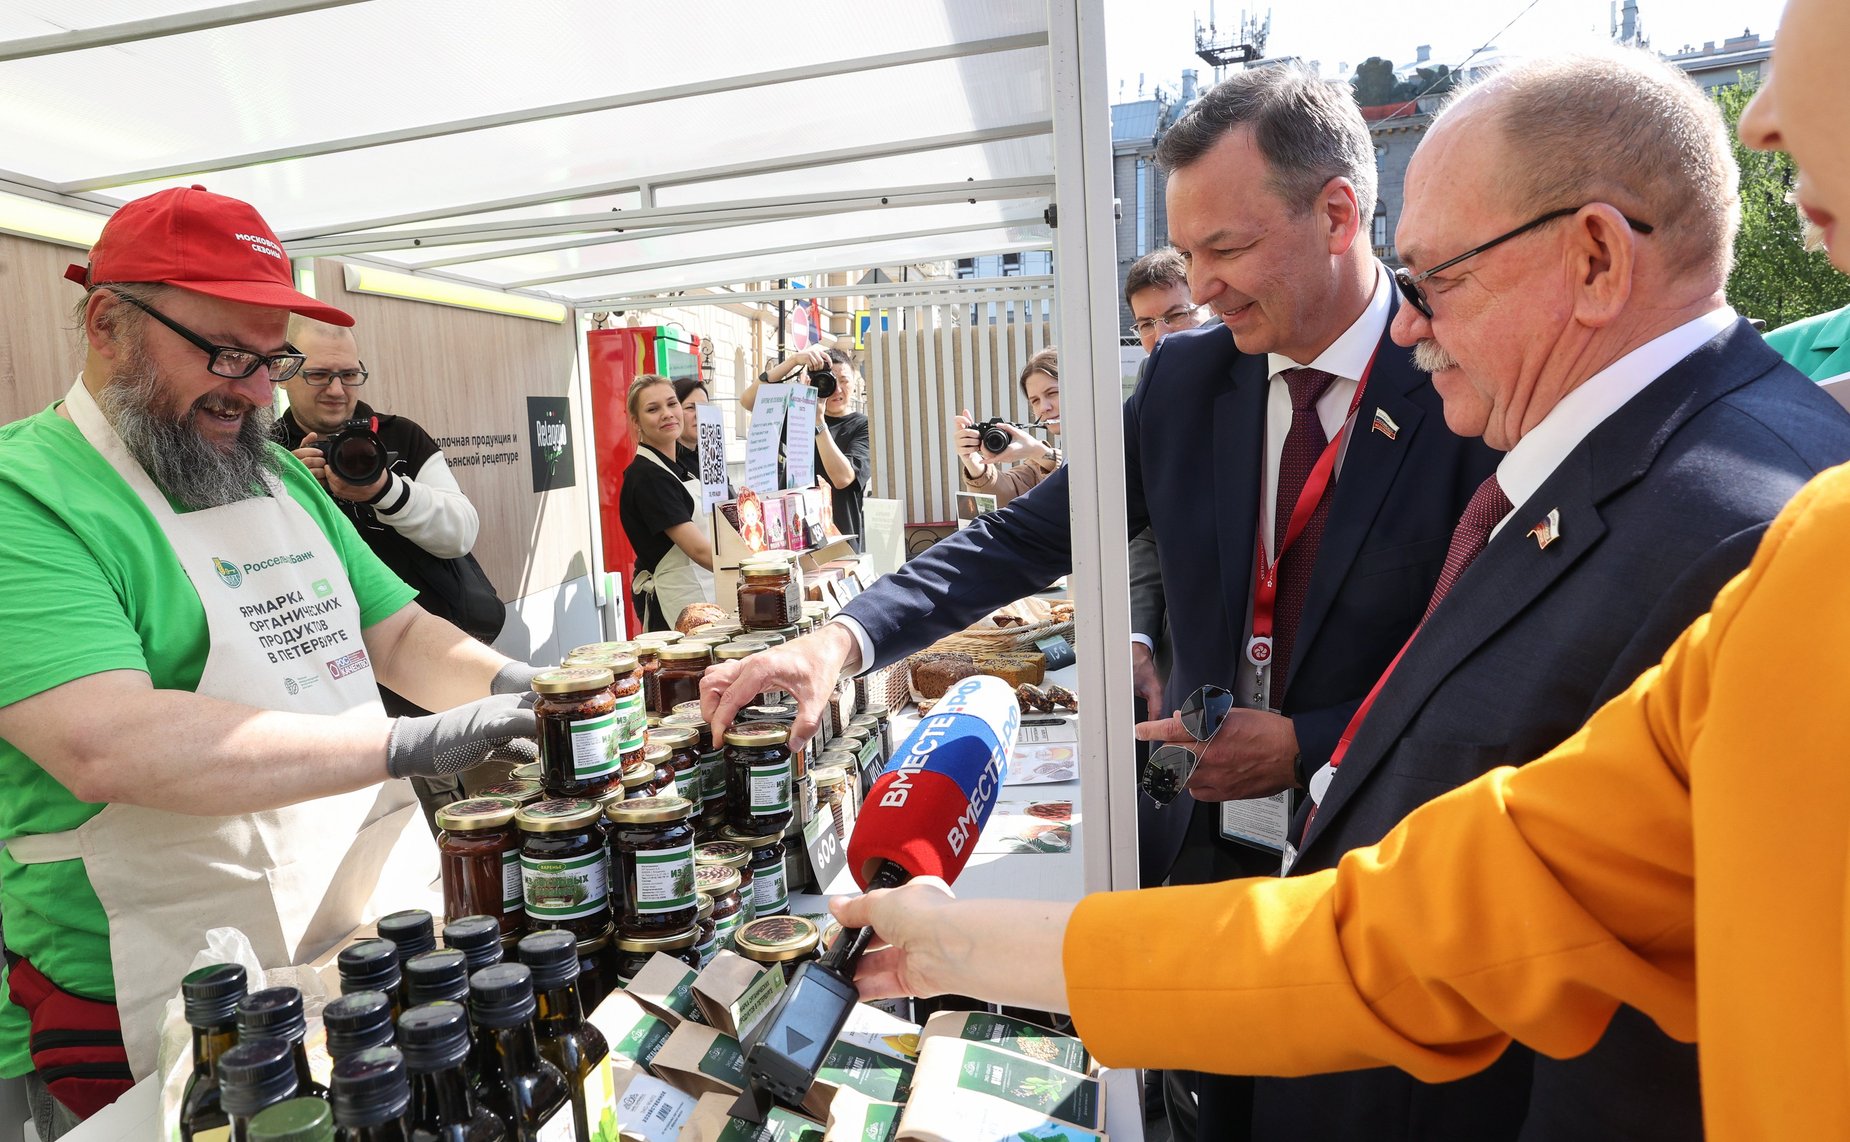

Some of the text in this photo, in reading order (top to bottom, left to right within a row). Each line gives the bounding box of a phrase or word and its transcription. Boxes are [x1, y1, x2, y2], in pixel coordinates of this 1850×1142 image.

[471, 434, 512, 448] продукция
[512, 434, 518, 443] и
[482, 451, 519, 467] рецептуре
[239, 590, 305, 618] ЯРМАРКА
[249, 597, 342, 632] ОРГАНИЧЕСКИХ
[259, 620, 328, 648] ПРОДУКТОВ
[267, 652, 278, 664] В
[277, 629, 348, 661] ПЕТЕРБУРГЕ
[817, 832, 836, 869] 600
